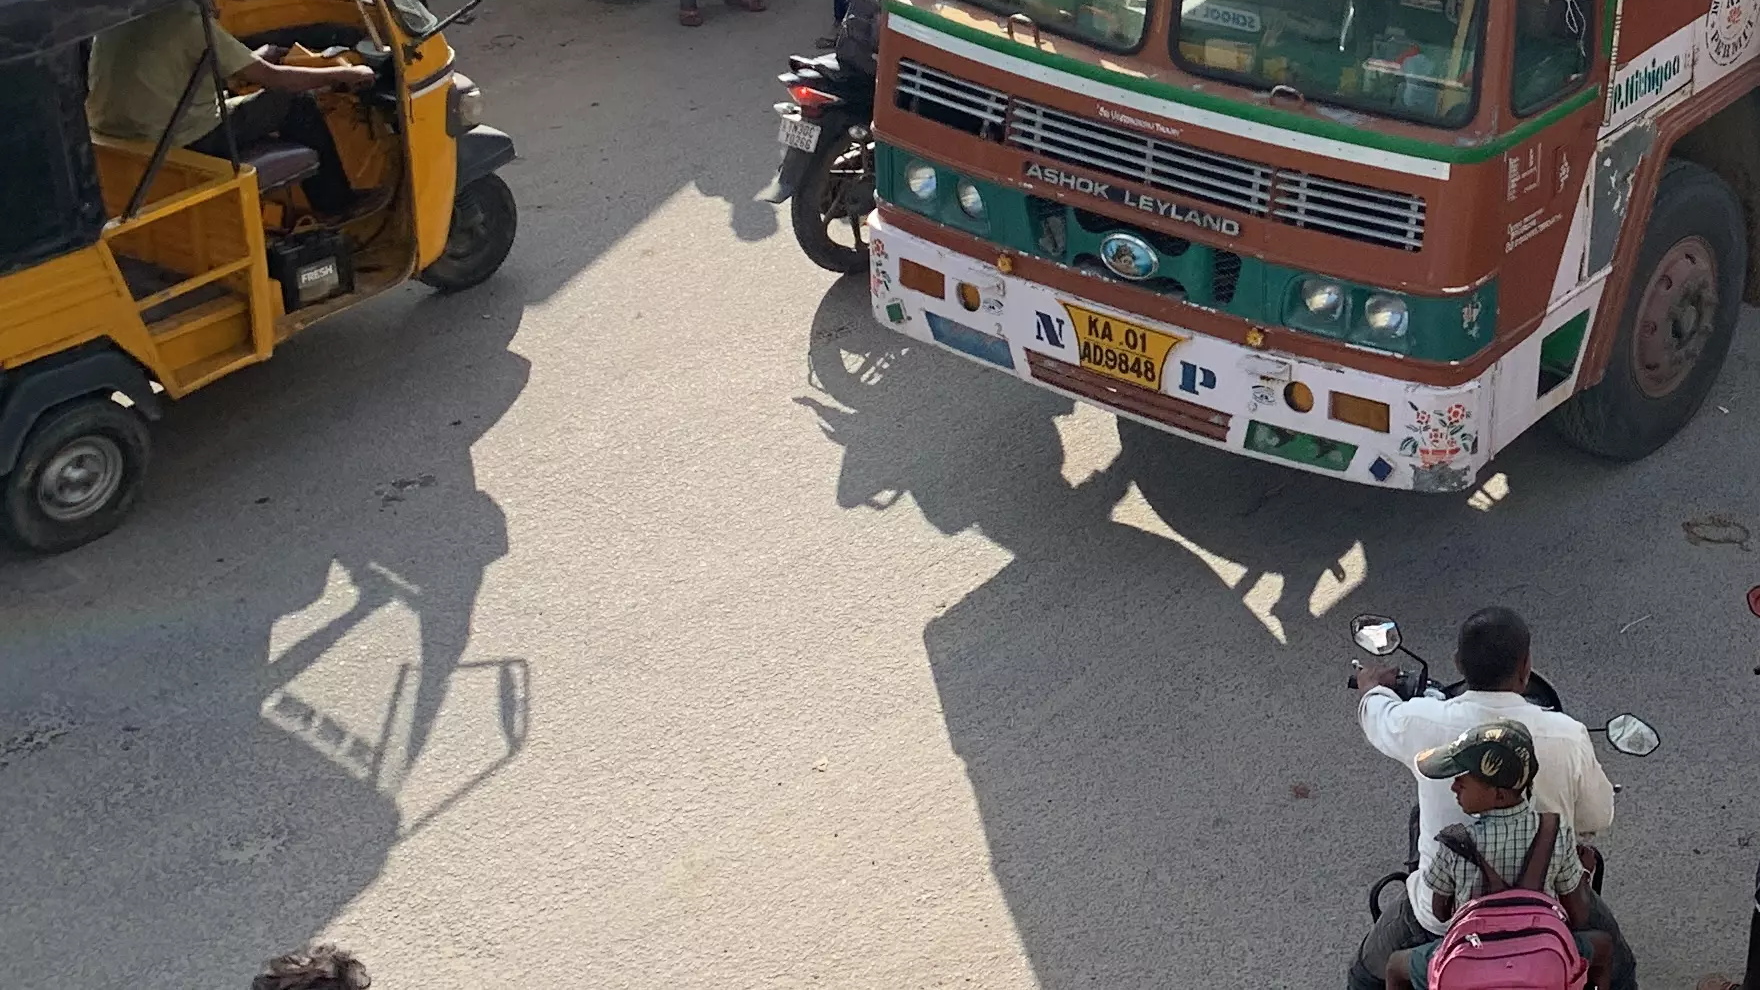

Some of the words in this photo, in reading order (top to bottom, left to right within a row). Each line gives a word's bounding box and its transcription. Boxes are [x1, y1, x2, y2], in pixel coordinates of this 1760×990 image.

[1026, 163, 1109, 200] ASHOK
[1124, 190, 1241, 237] LEYLAND
[301, 264, 333, 284] FRESH
[1035, 310, 1065, 349] N
[1087, 314, 1113, 343] KA
[1080, 340, 1157, 383] AD9848
[1179, 359, 1217, 396] P
